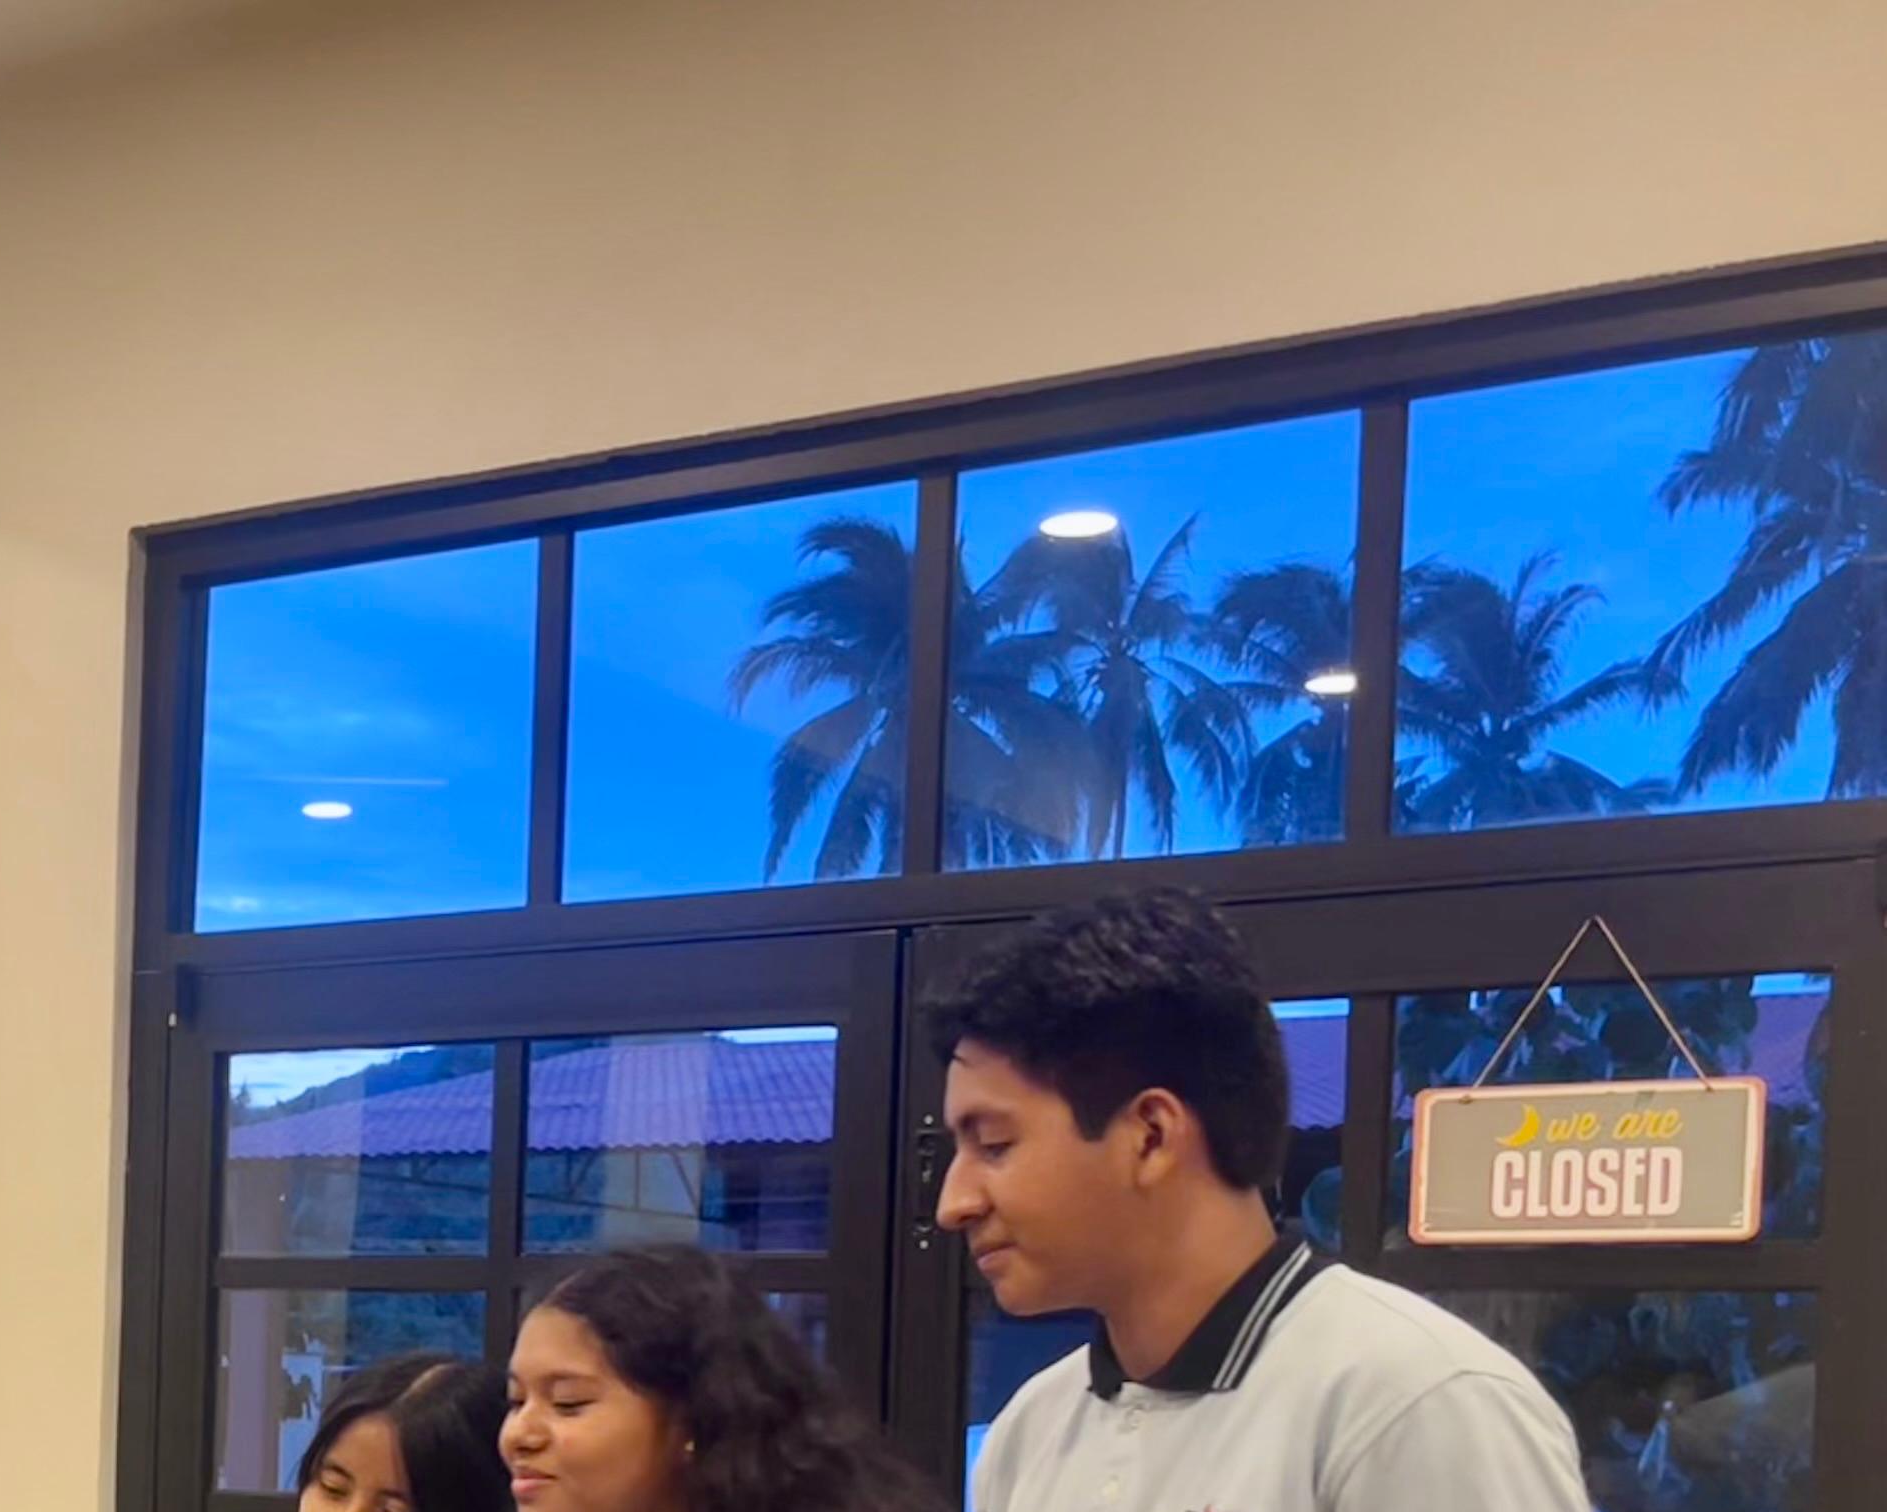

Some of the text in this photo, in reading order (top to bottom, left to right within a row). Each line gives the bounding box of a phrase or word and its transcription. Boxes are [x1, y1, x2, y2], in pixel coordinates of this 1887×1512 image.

[1546, 1107, 1684, 1144] we are
[1490, 1146, 1683, 1219] CLOSED
